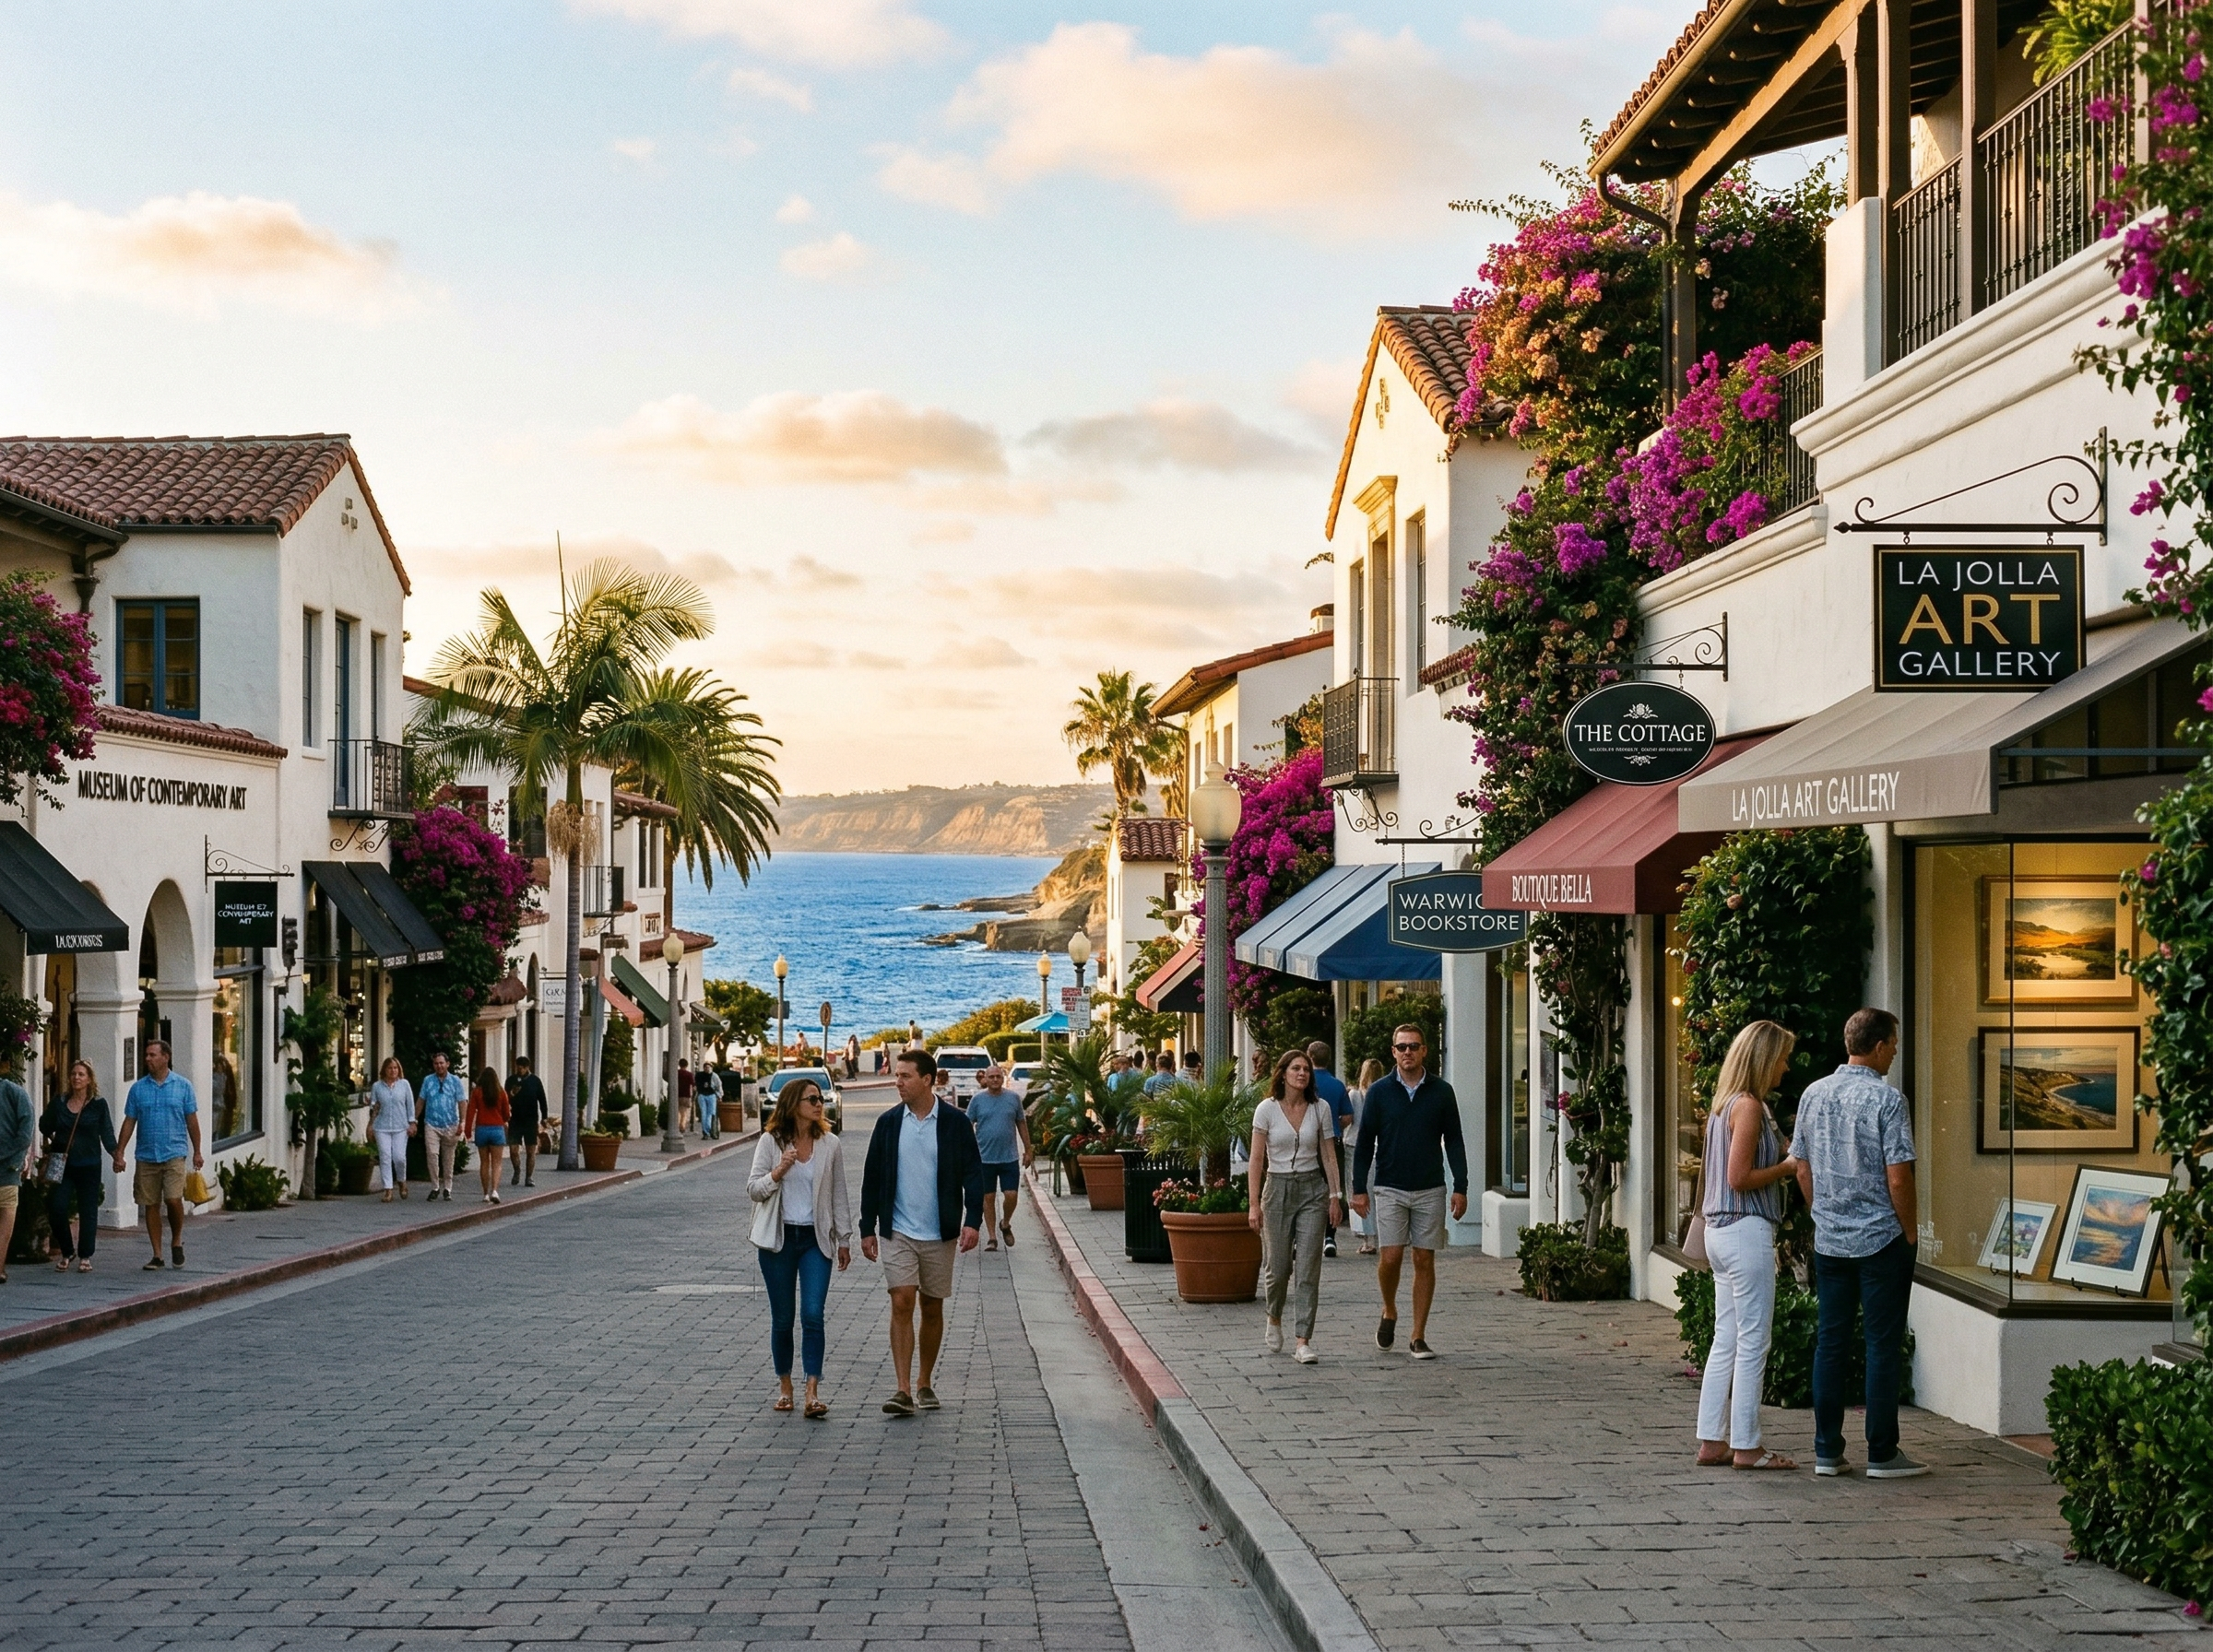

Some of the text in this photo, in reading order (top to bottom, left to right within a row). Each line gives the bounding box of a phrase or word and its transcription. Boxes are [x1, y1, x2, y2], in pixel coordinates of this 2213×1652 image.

[1899, 560, 2060, 592] LA JOLLA
[1899, 594, 2061, 644] ART
[1899, 651, 2062, 677] GALLERY
[1574, 724, 1706, 742] THE COTTAGE
[78, 770, 247, 810] MUSEUM OF CONTEMPORARY ART
[1733, 771, 1900, 829] LA JOLLA ART GALLERY
[1398, 893, 1486, 910] WARWIC
[1511, 874, 1592, 909] BOUTIQUE BELLA
[1399, 914, 1520, 931] BOOKSTORE
